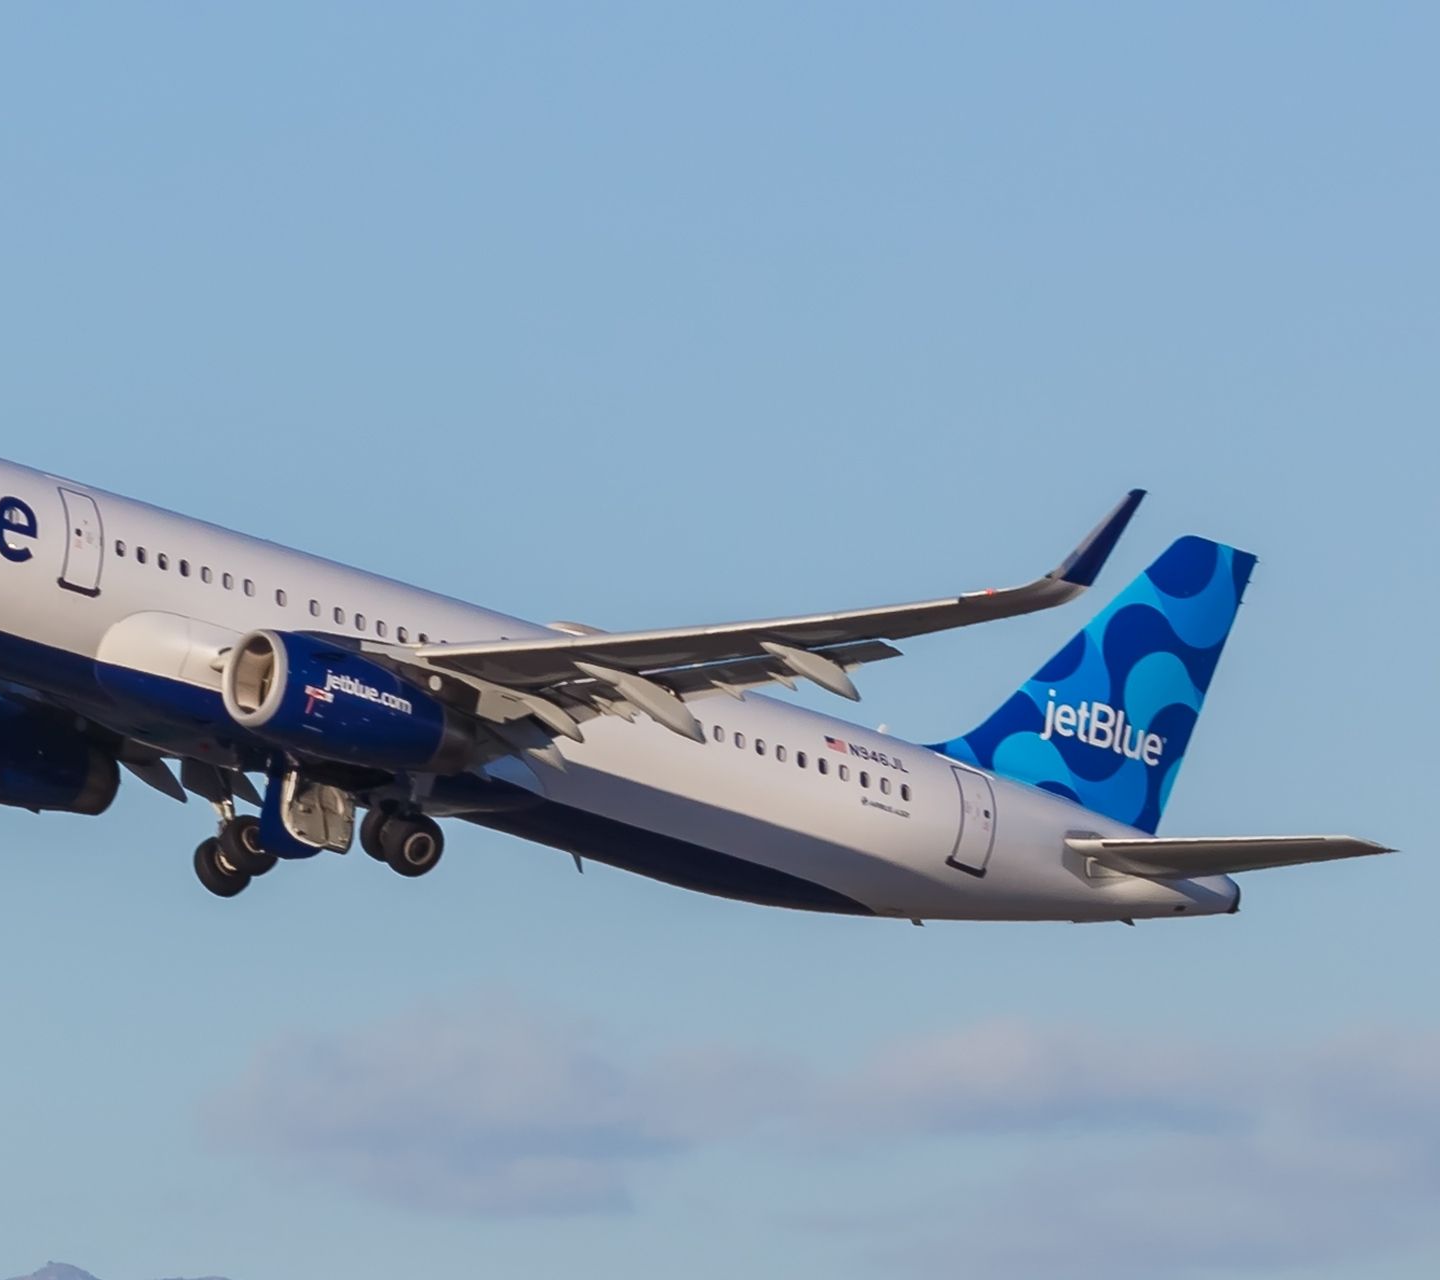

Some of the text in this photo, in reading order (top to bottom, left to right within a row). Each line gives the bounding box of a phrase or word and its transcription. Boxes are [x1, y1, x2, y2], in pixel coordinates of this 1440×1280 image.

[324, 669, 413, 714] jetblue.com
[1040, 689, 1163, 766] jetBlue
[848, 742, 910, 773] N946JL
